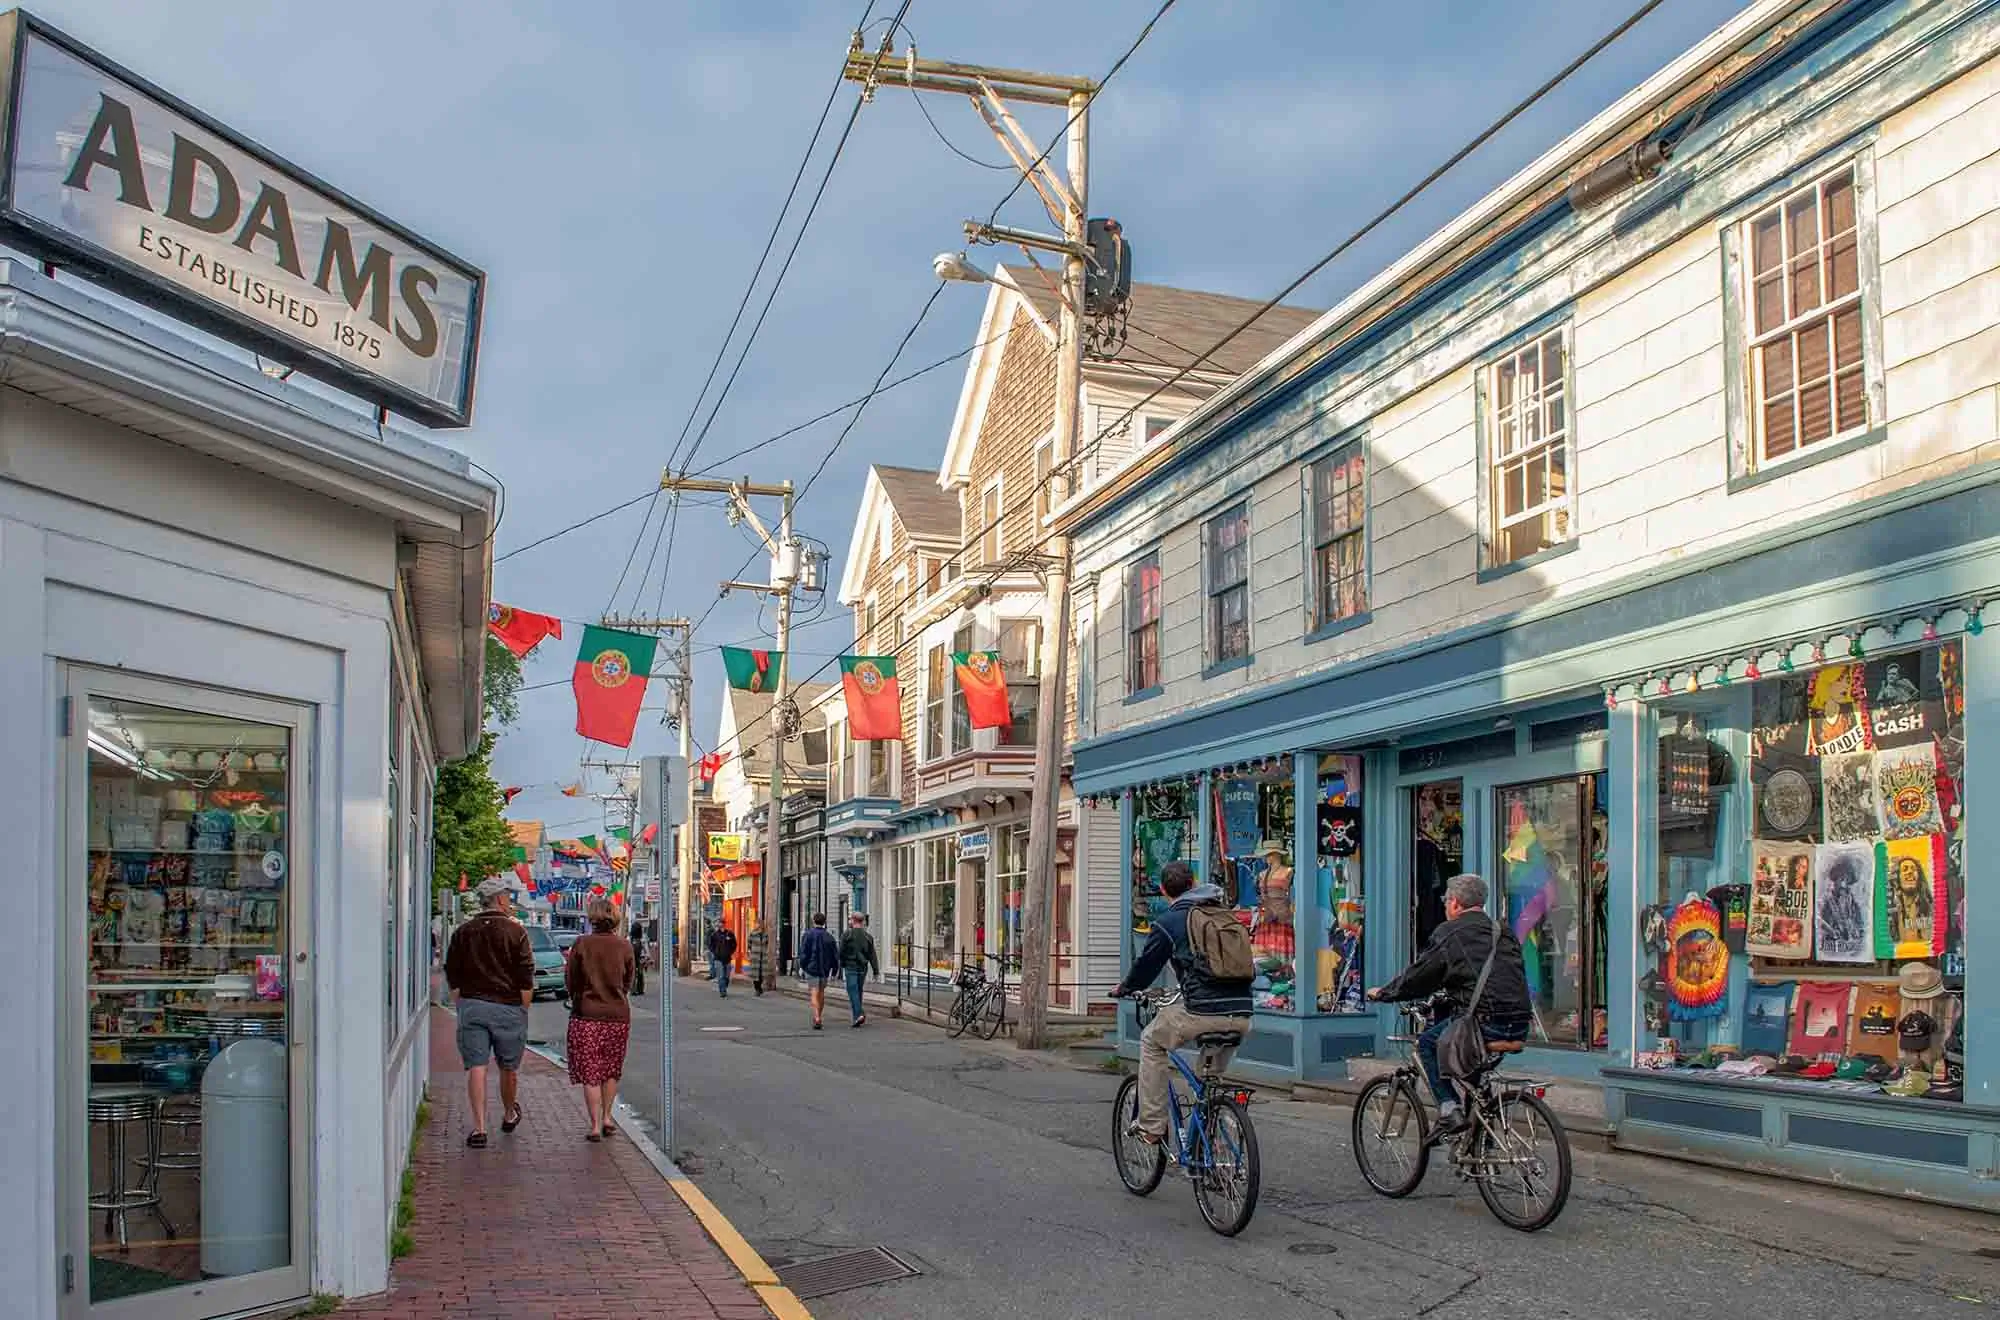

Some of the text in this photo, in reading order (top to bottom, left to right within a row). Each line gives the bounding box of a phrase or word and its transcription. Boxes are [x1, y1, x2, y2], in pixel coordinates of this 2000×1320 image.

[63, 92, 438, 358] ADAMS
[138, 226, 381, 359] ESTABLISHED 1875
[1875, 714, 1923, 737] CASH
[1786, 891, 1808, 908] BOB
